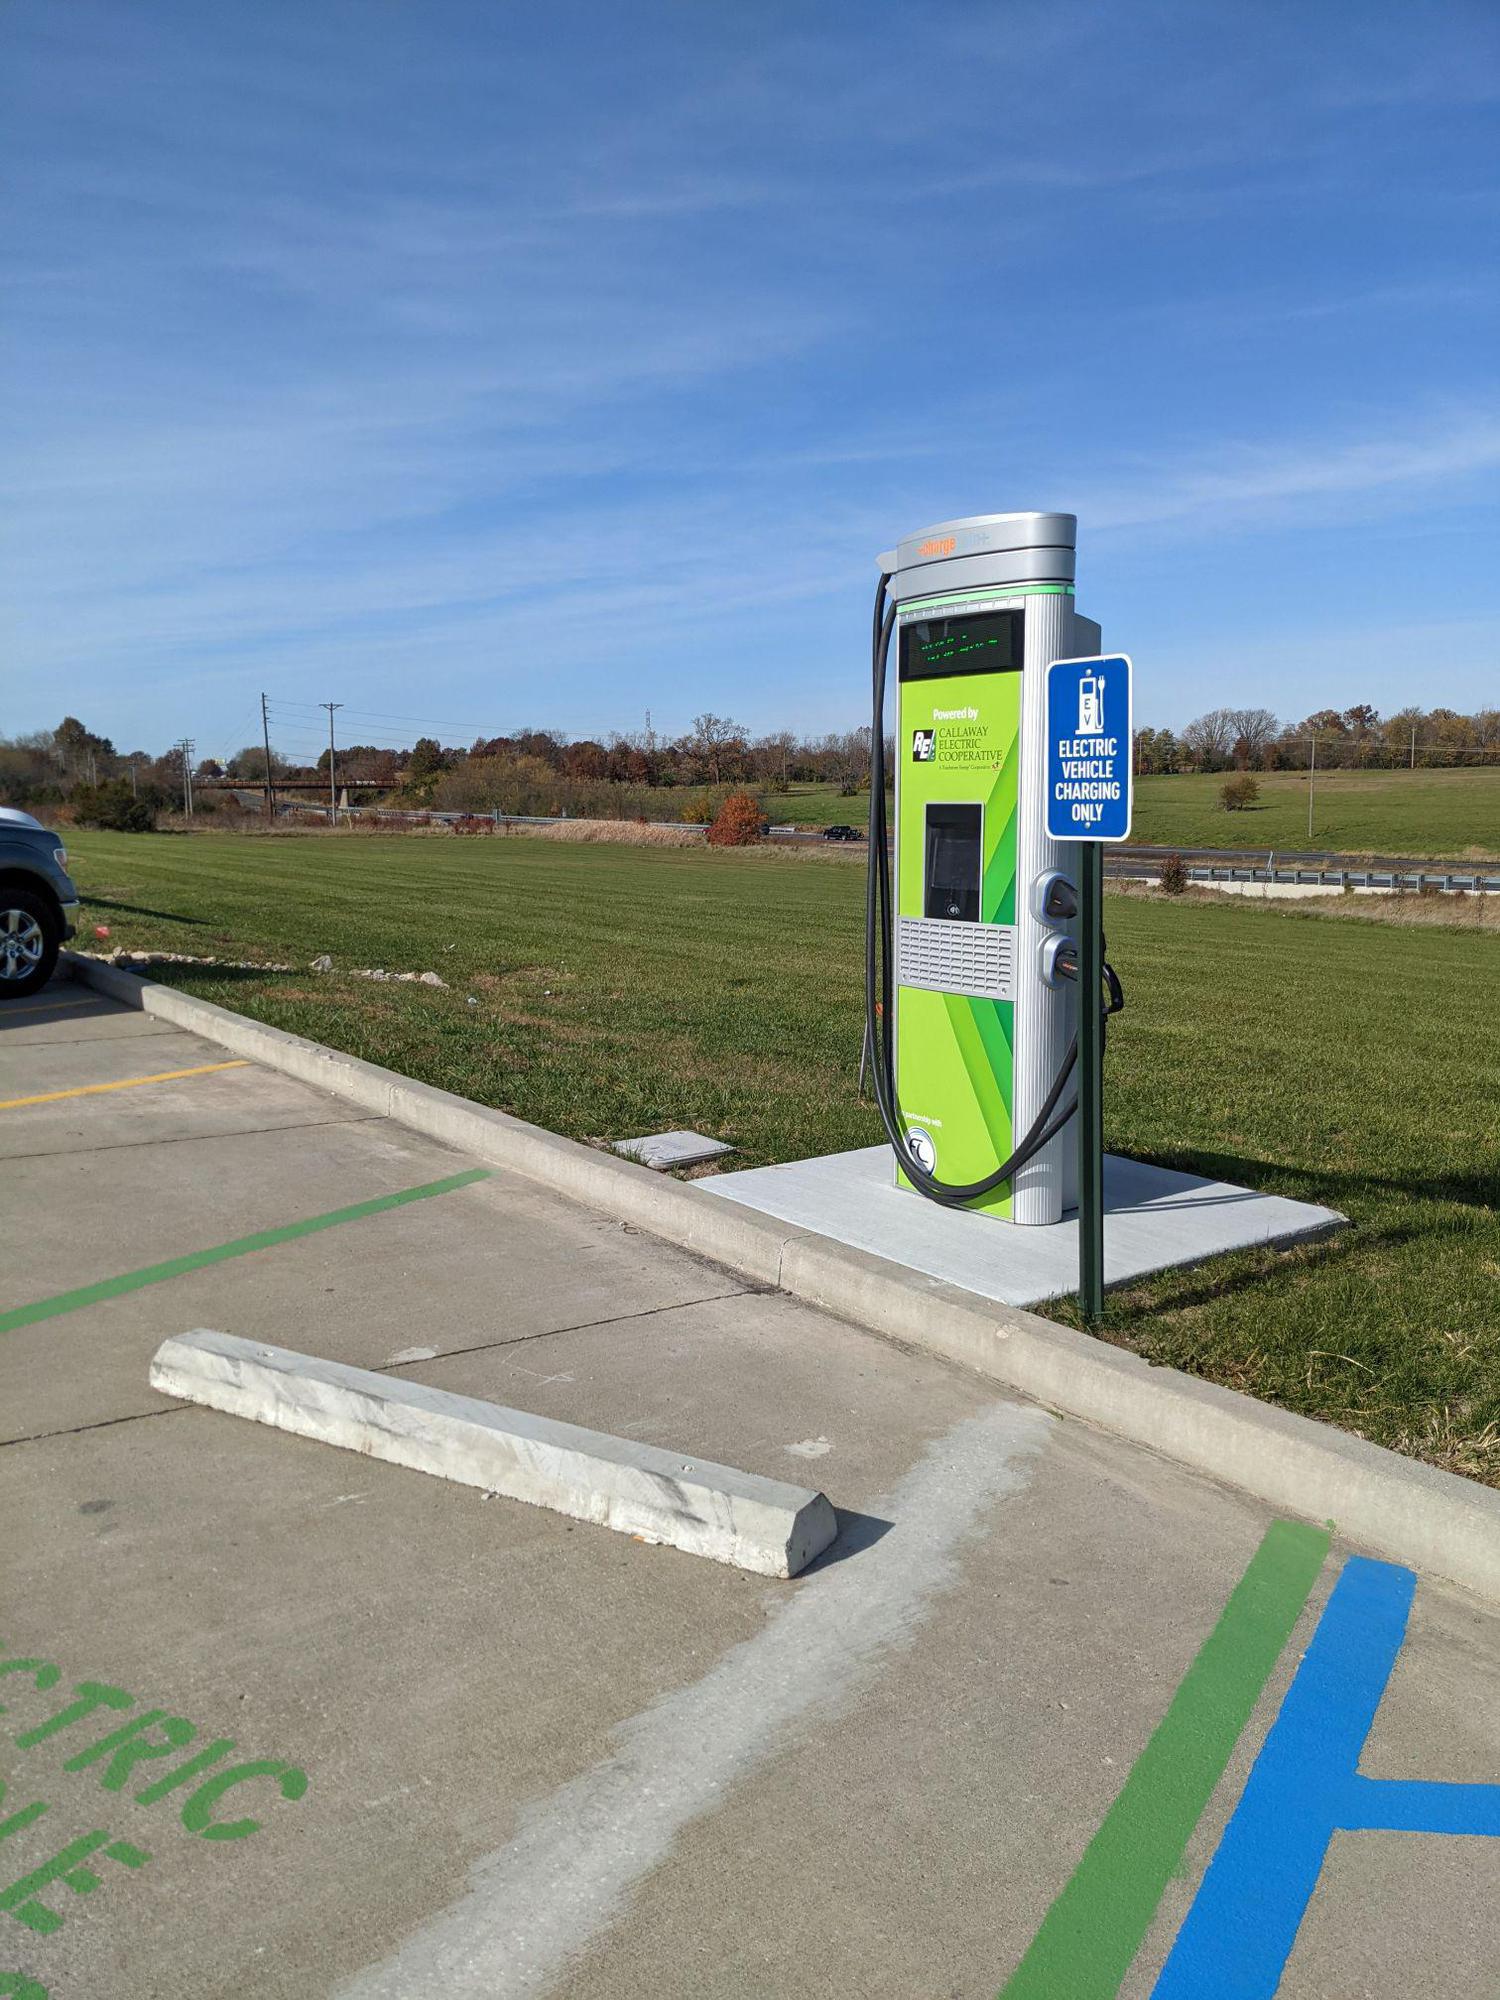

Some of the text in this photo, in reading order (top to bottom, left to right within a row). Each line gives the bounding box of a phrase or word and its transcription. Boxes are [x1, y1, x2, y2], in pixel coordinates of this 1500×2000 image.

[933, 706, 979, 721] Powered by
[939, 726, 989, 738] CALLAWAY
[939, 738, 981, 750] ELECTRIC
[1059, 738, 1117, 757] ELECTRIC
[938, 749, 1003, 762] COOPERATIVE
[1062, 760, 1114, 779] VEHICLE
[1055, 781, 1120, 801] CHARGING
[1071, 803, 1104, 821] ONLY
